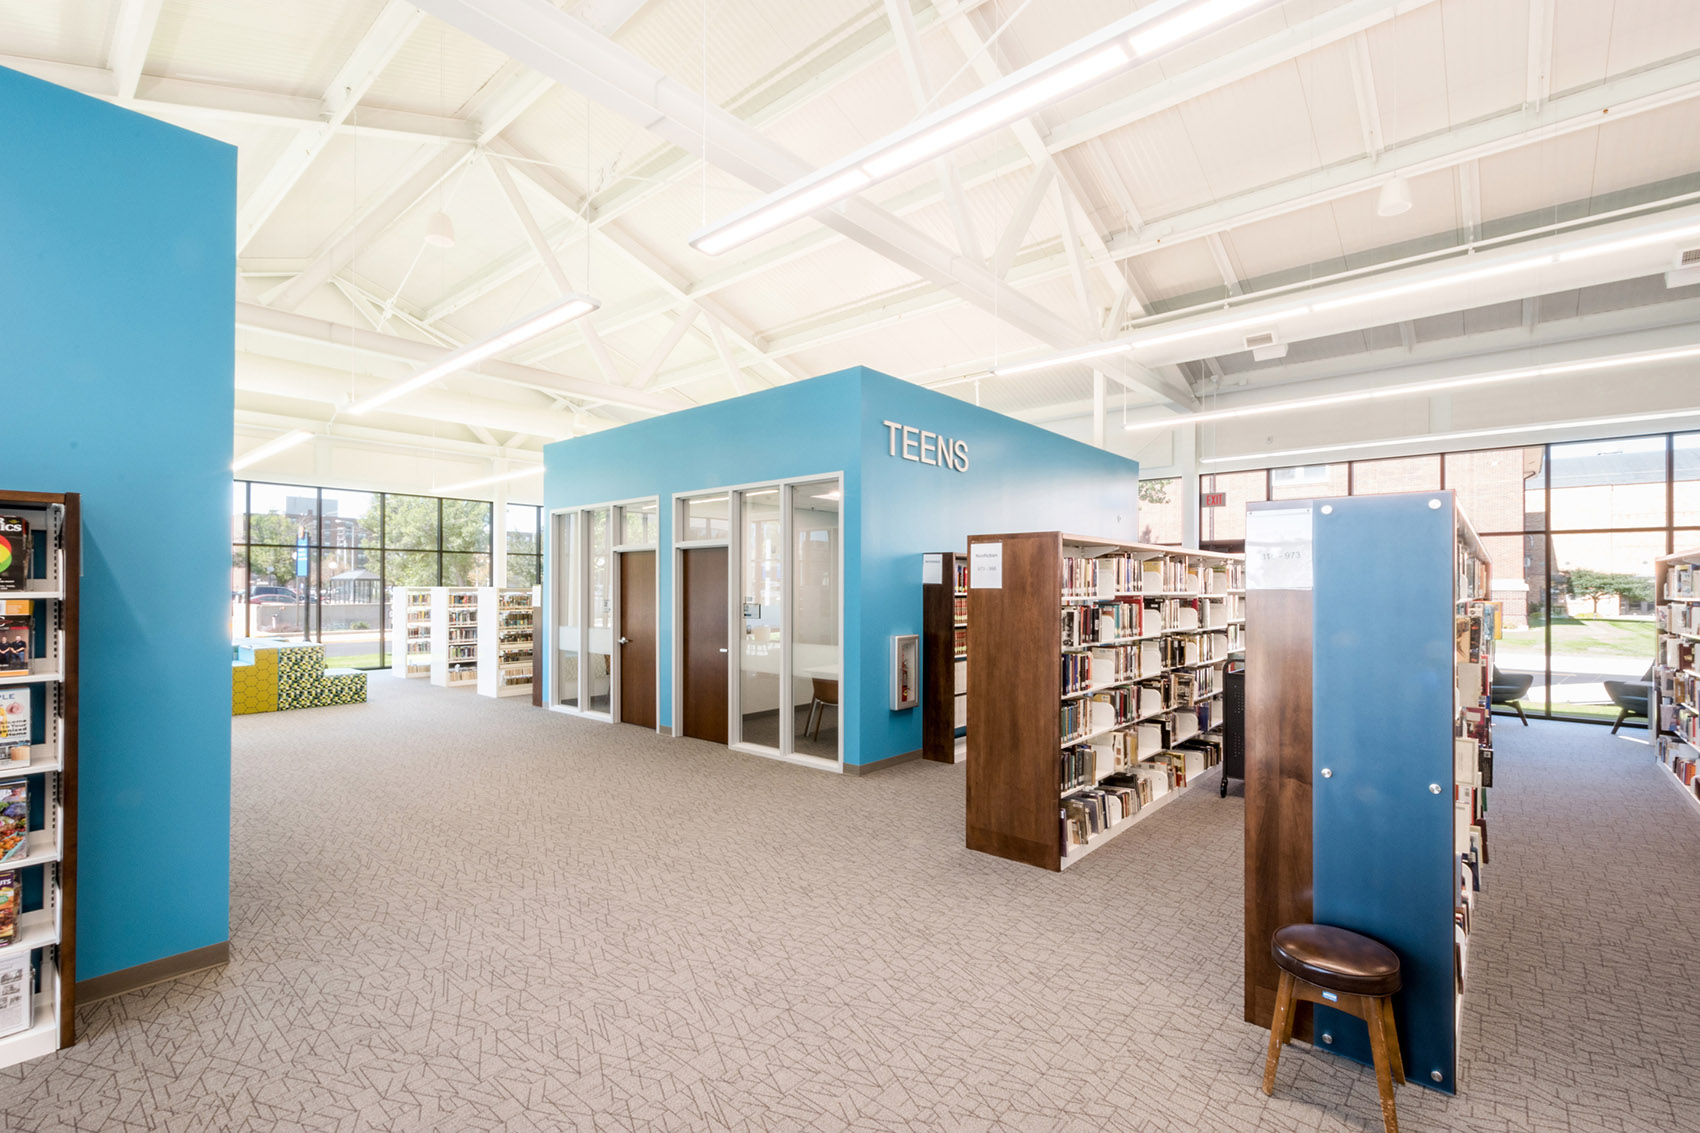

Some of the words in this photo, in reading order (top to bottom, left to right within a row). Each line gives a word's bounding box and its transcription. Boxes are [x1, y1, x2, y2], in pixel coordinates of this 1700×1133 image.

[882, 419, 969, 473] TEENS
[1206, 494, 1223, 505] EXIT
[1284, 551, 1301, 560] 973
